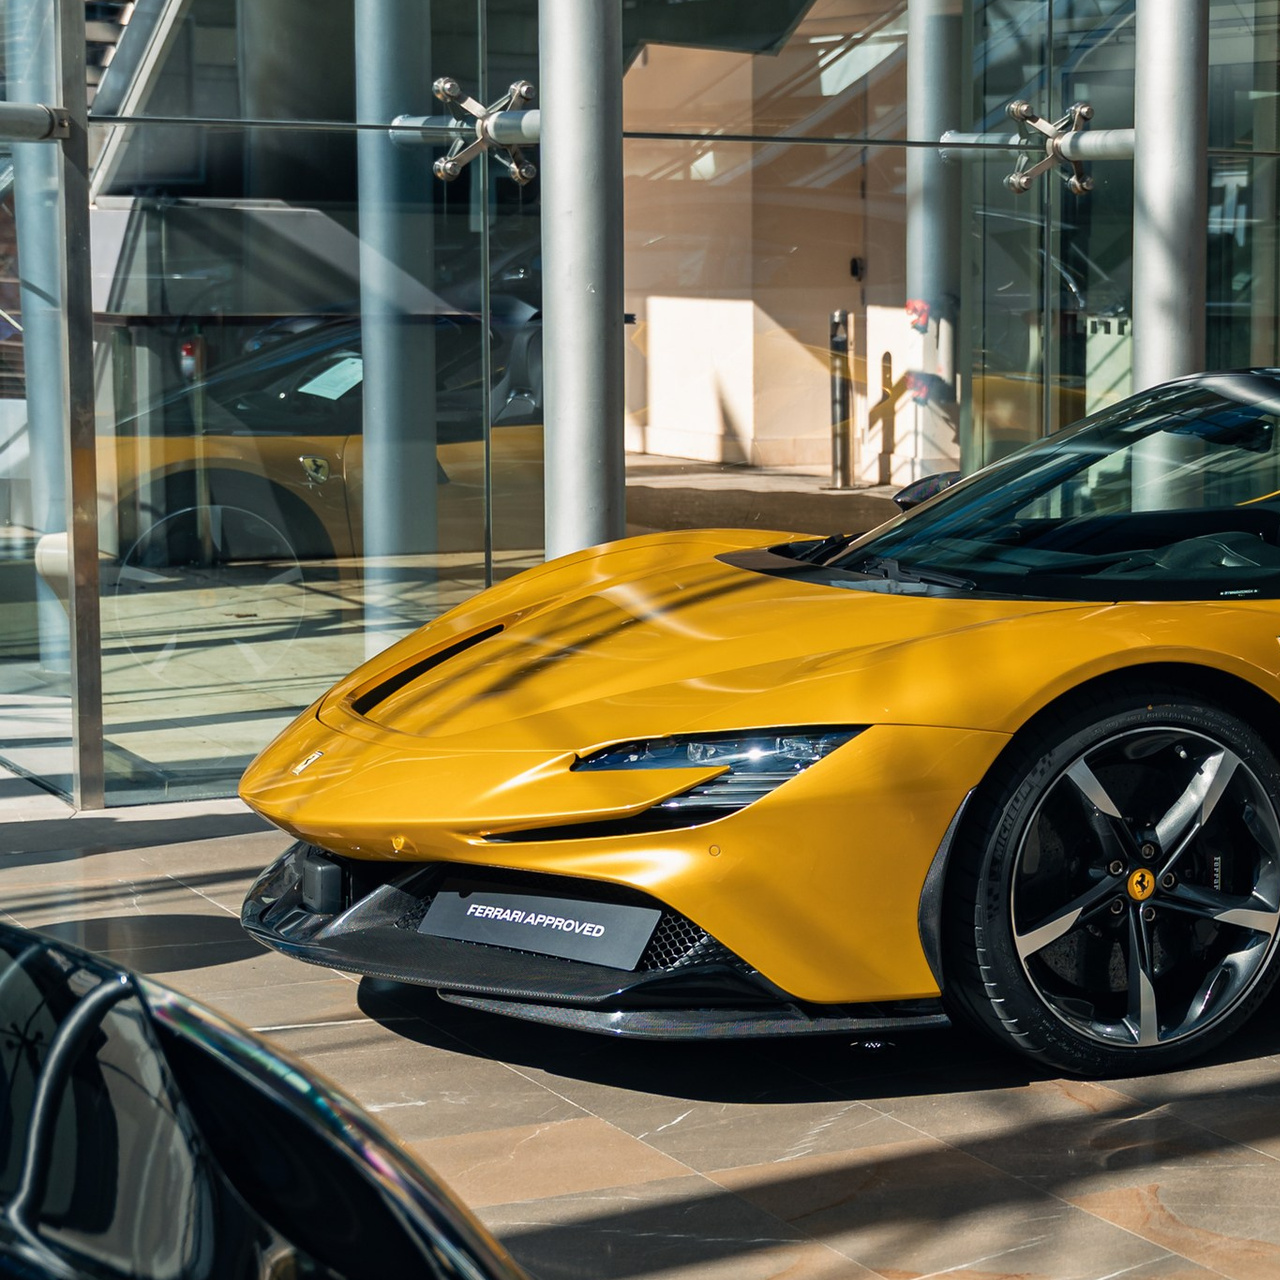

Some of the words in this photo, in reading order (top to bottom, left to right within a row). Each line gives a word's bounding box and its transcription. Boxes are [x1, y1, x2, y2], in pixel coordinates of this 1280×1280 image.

[993, 778, 1034, 859] MICHELIN
[467, 904, 526, 923] FERRARI
[523, 913, 606, 938] APPROVED
